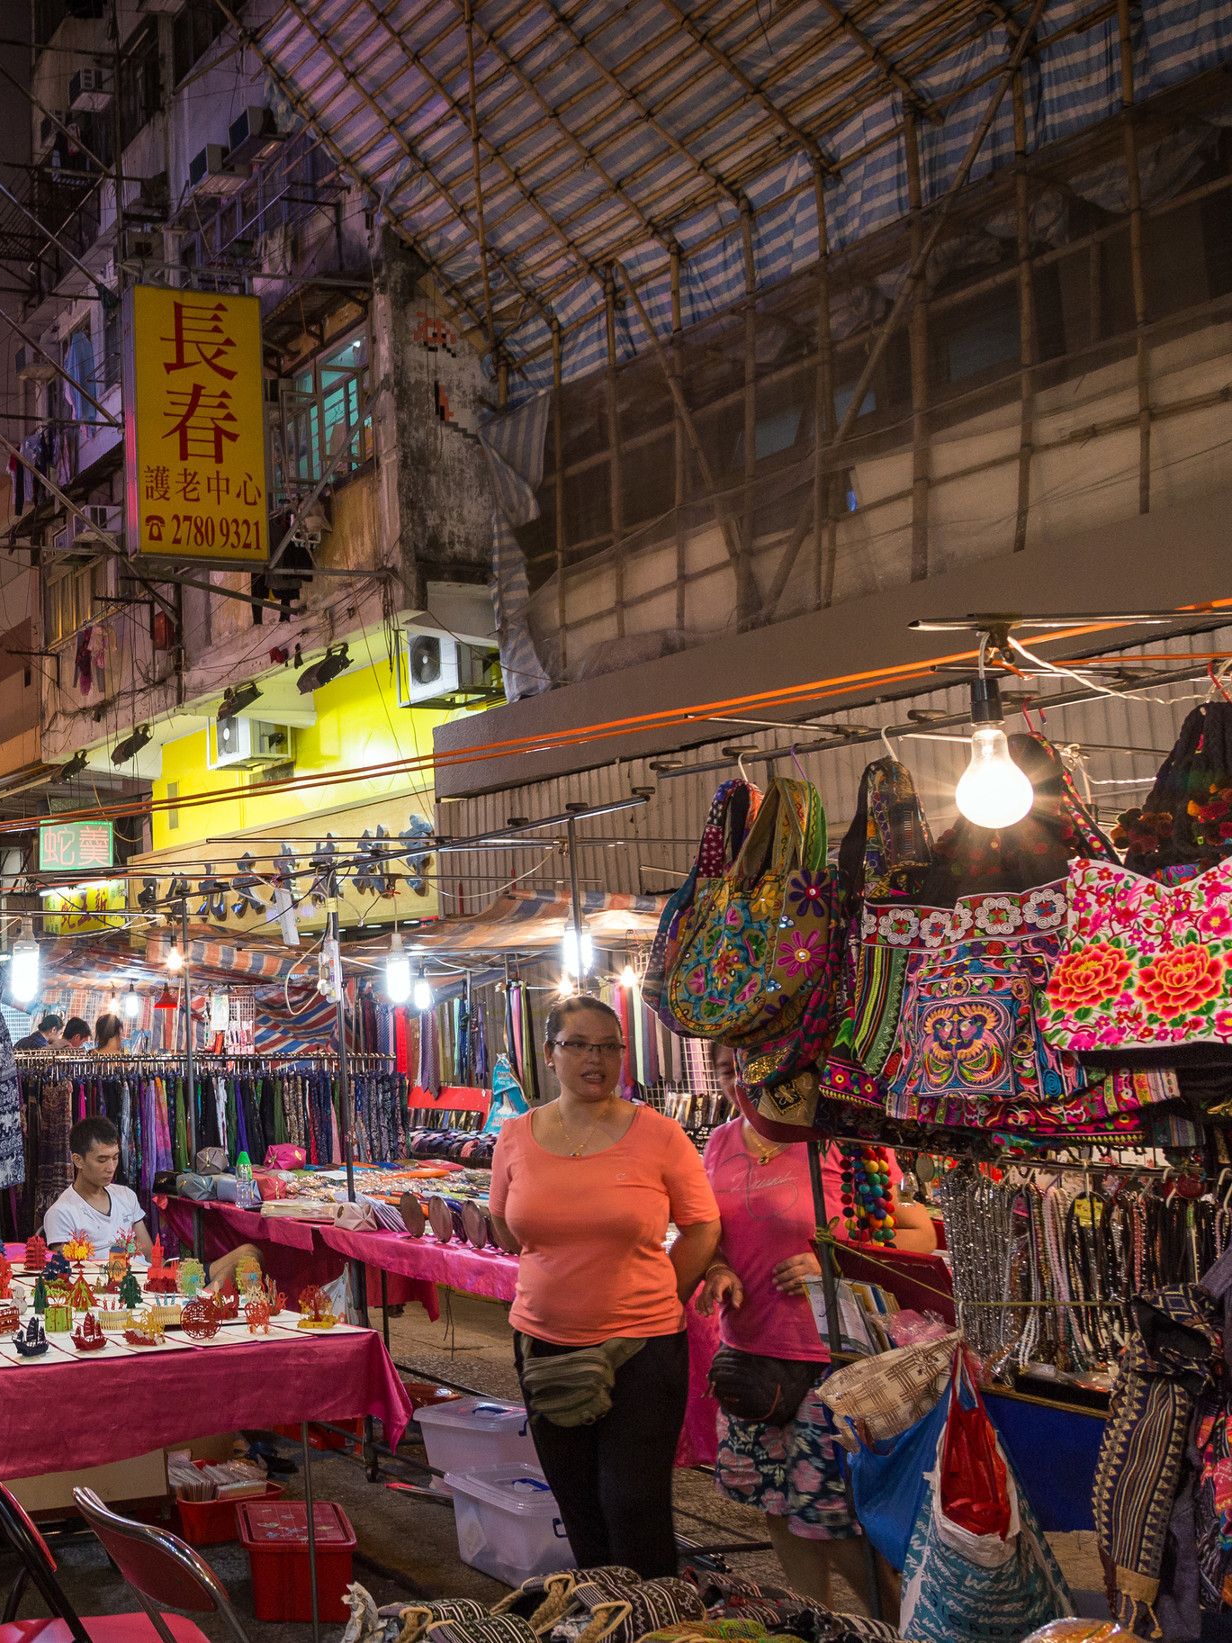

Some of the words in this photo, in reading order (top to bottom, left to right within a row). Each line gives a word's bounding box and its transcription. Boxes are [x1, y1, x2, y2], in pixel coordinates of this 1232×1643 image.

[160, 301, 240, 464] 長春
[144, 465, 262, 507] 護老中心
